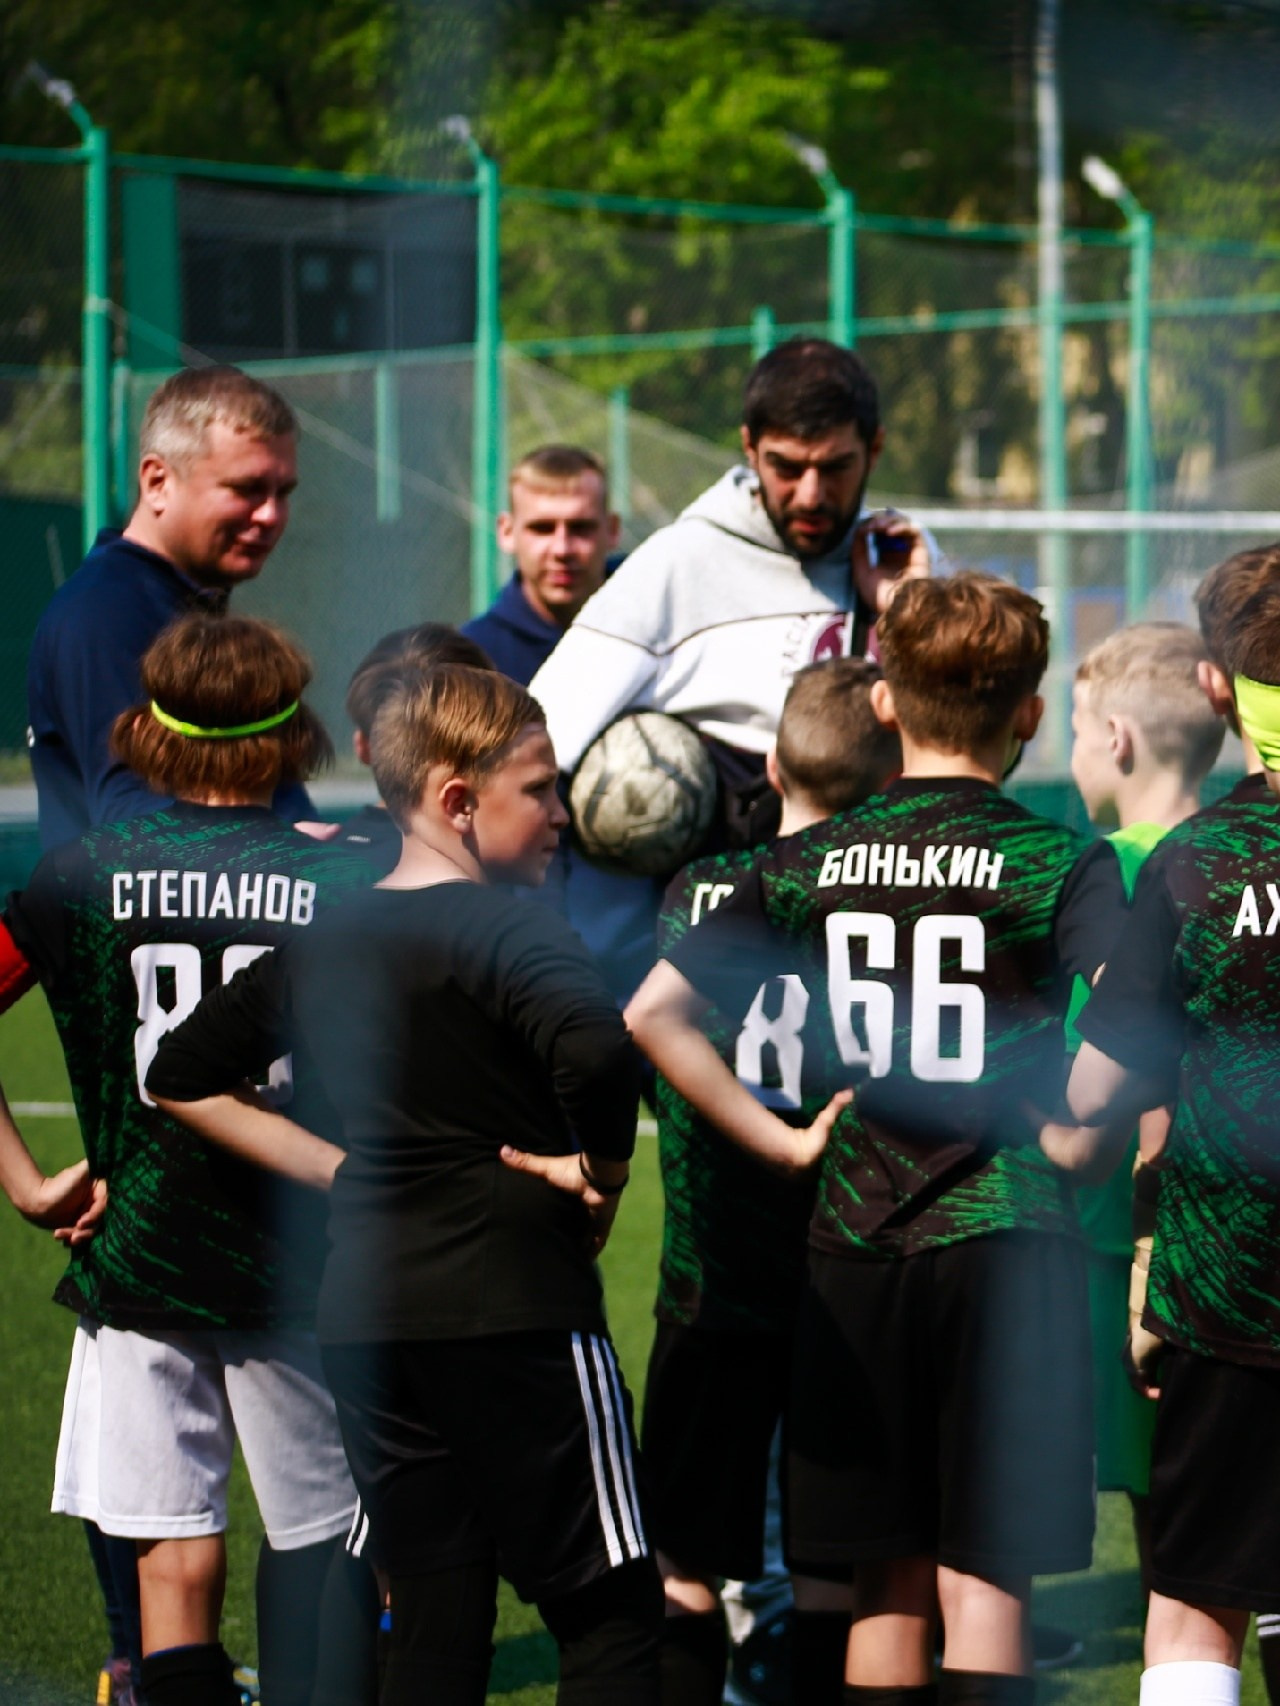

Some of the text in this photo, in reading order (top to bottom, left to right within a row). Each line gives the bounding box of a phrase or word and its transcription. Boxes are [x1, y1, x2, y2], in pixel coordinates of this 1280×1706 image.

[817, 843, 1004, 890] БОНЬКИН
[112, 869, 318, 926] СТЕПАНОВ
[825, 911, 986, 1083] 66
